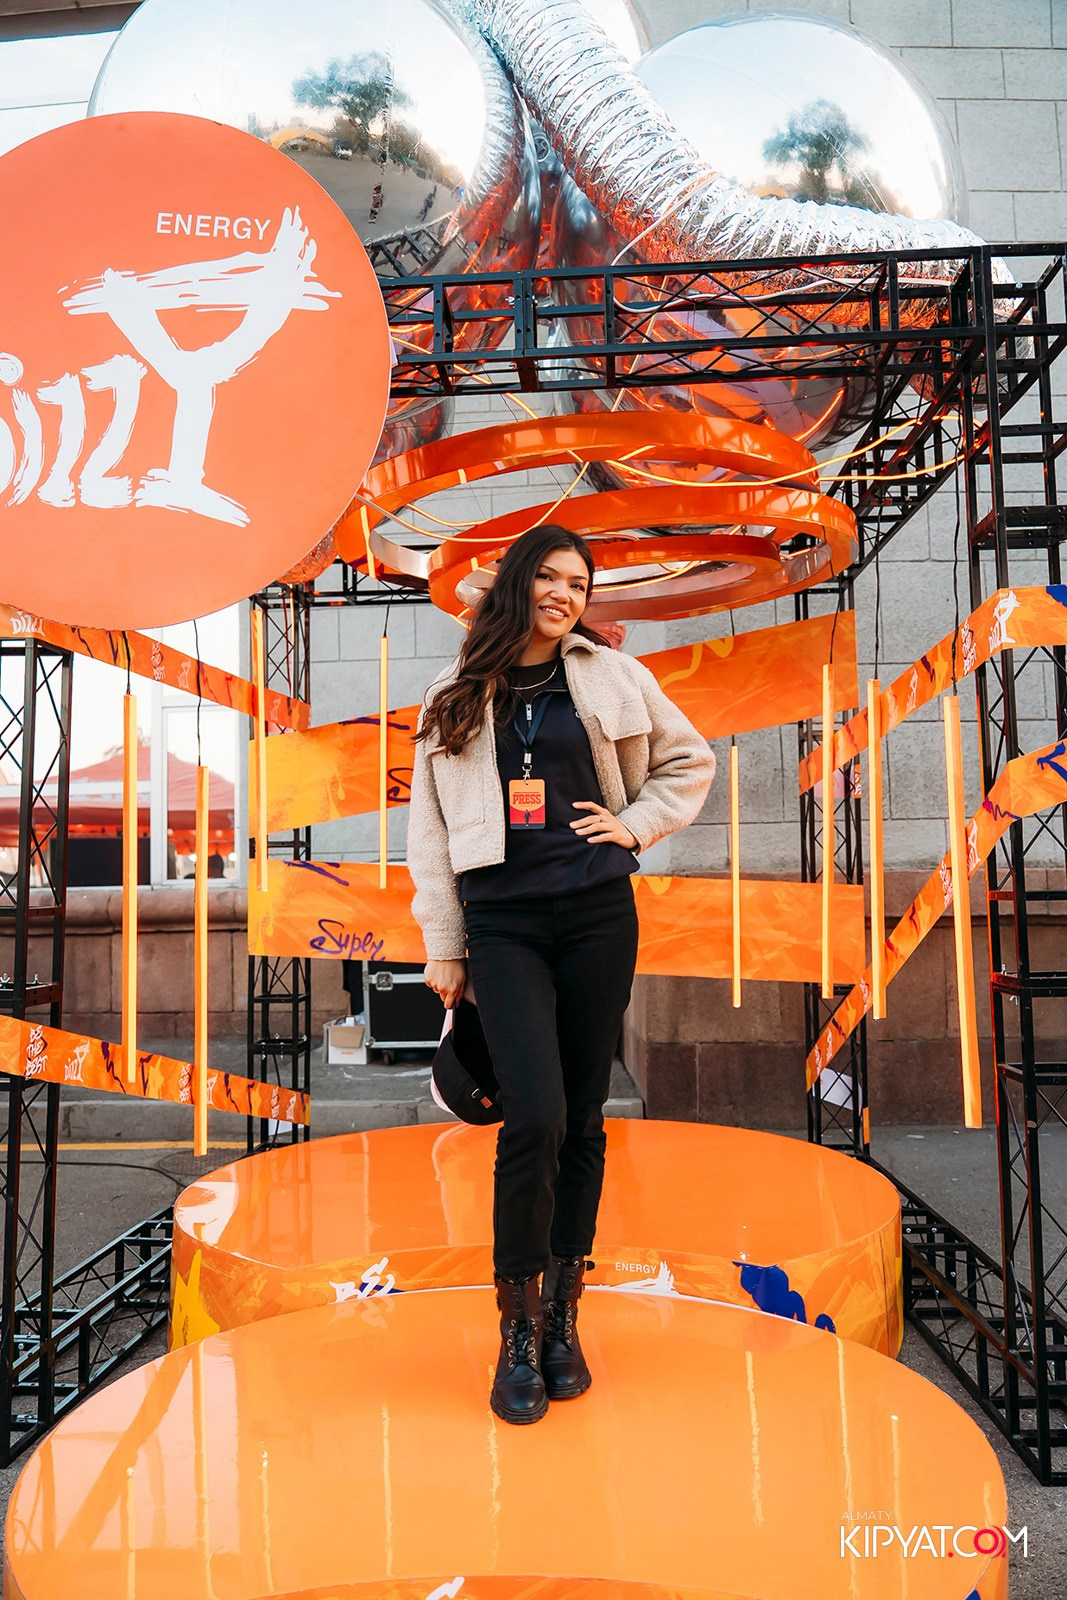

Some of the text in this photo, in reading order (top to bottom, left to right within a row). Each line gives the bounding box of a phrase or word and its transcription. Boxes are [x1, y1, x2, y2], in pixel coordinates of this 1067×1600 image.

[156, 212, 271, 240] ENERGY
[512, 793, 542, 805] PRESS
[615, 1261, 657, 1274] ENERGY
